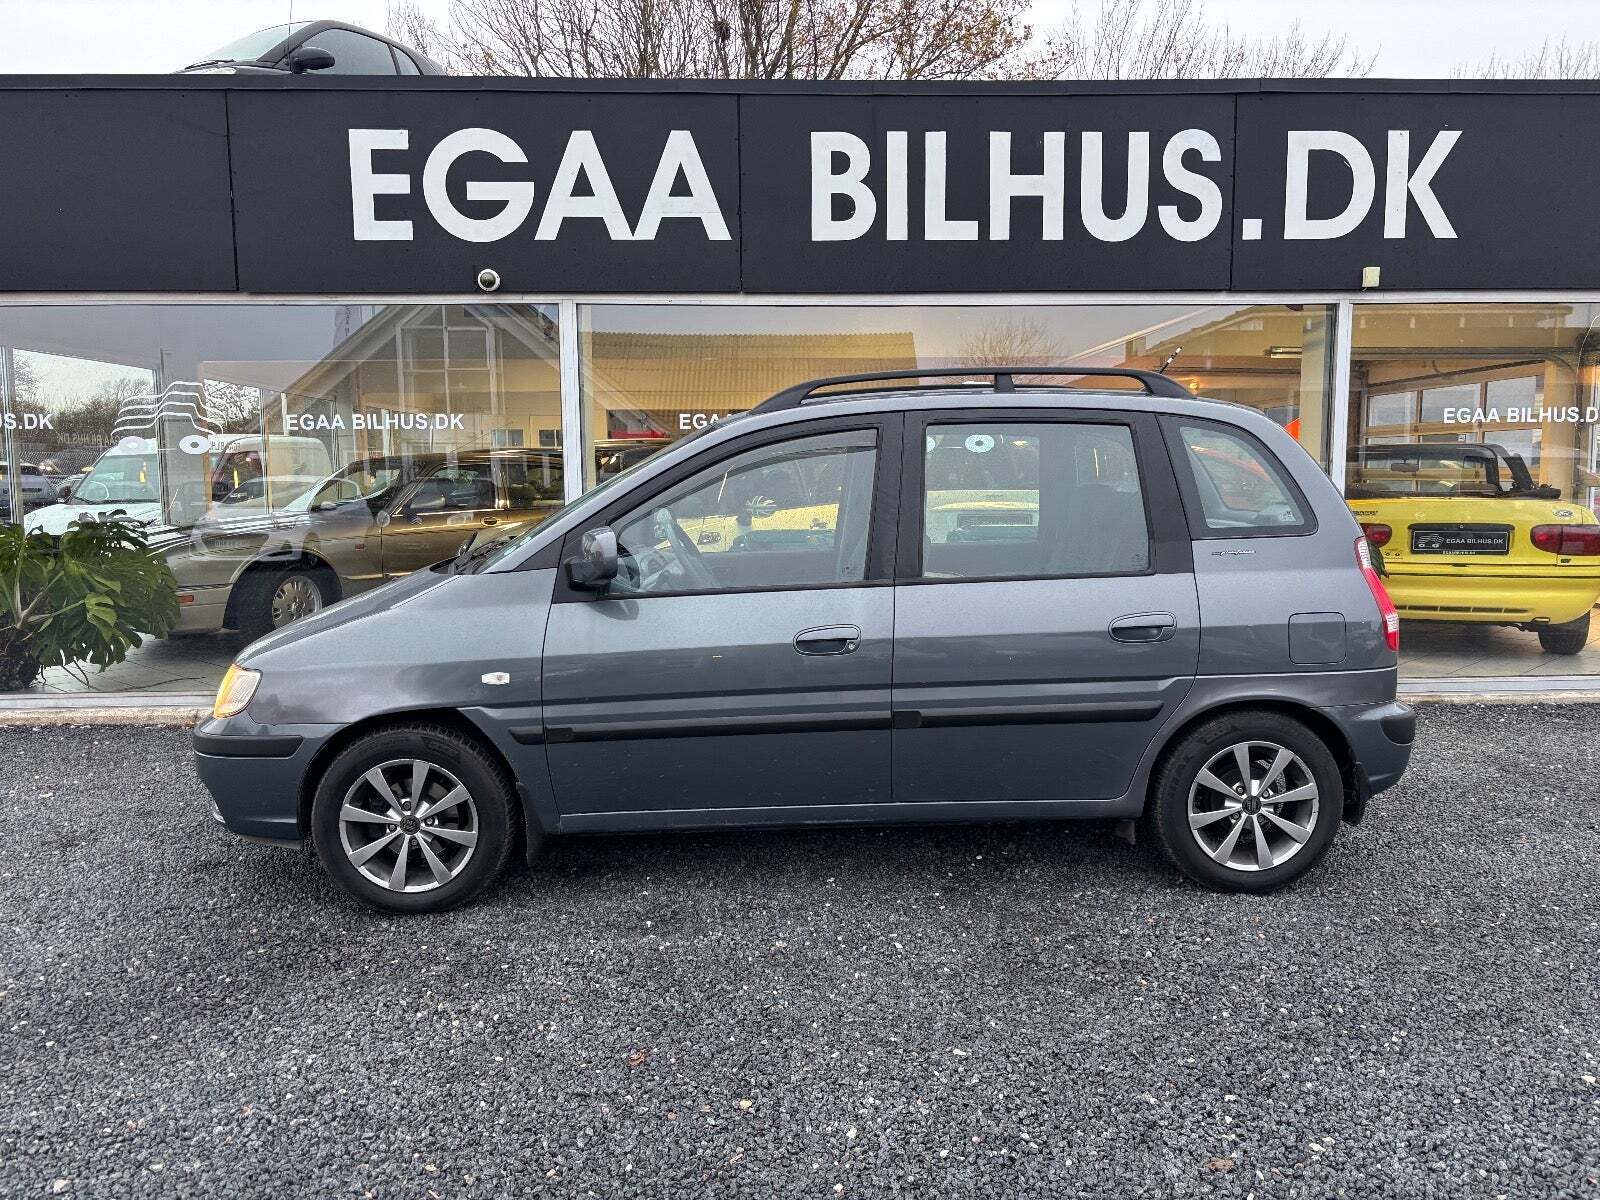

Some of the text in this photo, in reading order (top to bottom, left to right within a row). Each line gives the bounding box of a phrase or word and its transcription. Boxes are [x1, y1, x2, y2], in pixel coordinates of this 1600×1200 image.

[348, 128, 1463, 242] EGAA BILHUS.DK
[286, 413, 465, 431] EGAA BILHUS.DK
[1443, 407, 1500, 424] EGAA
